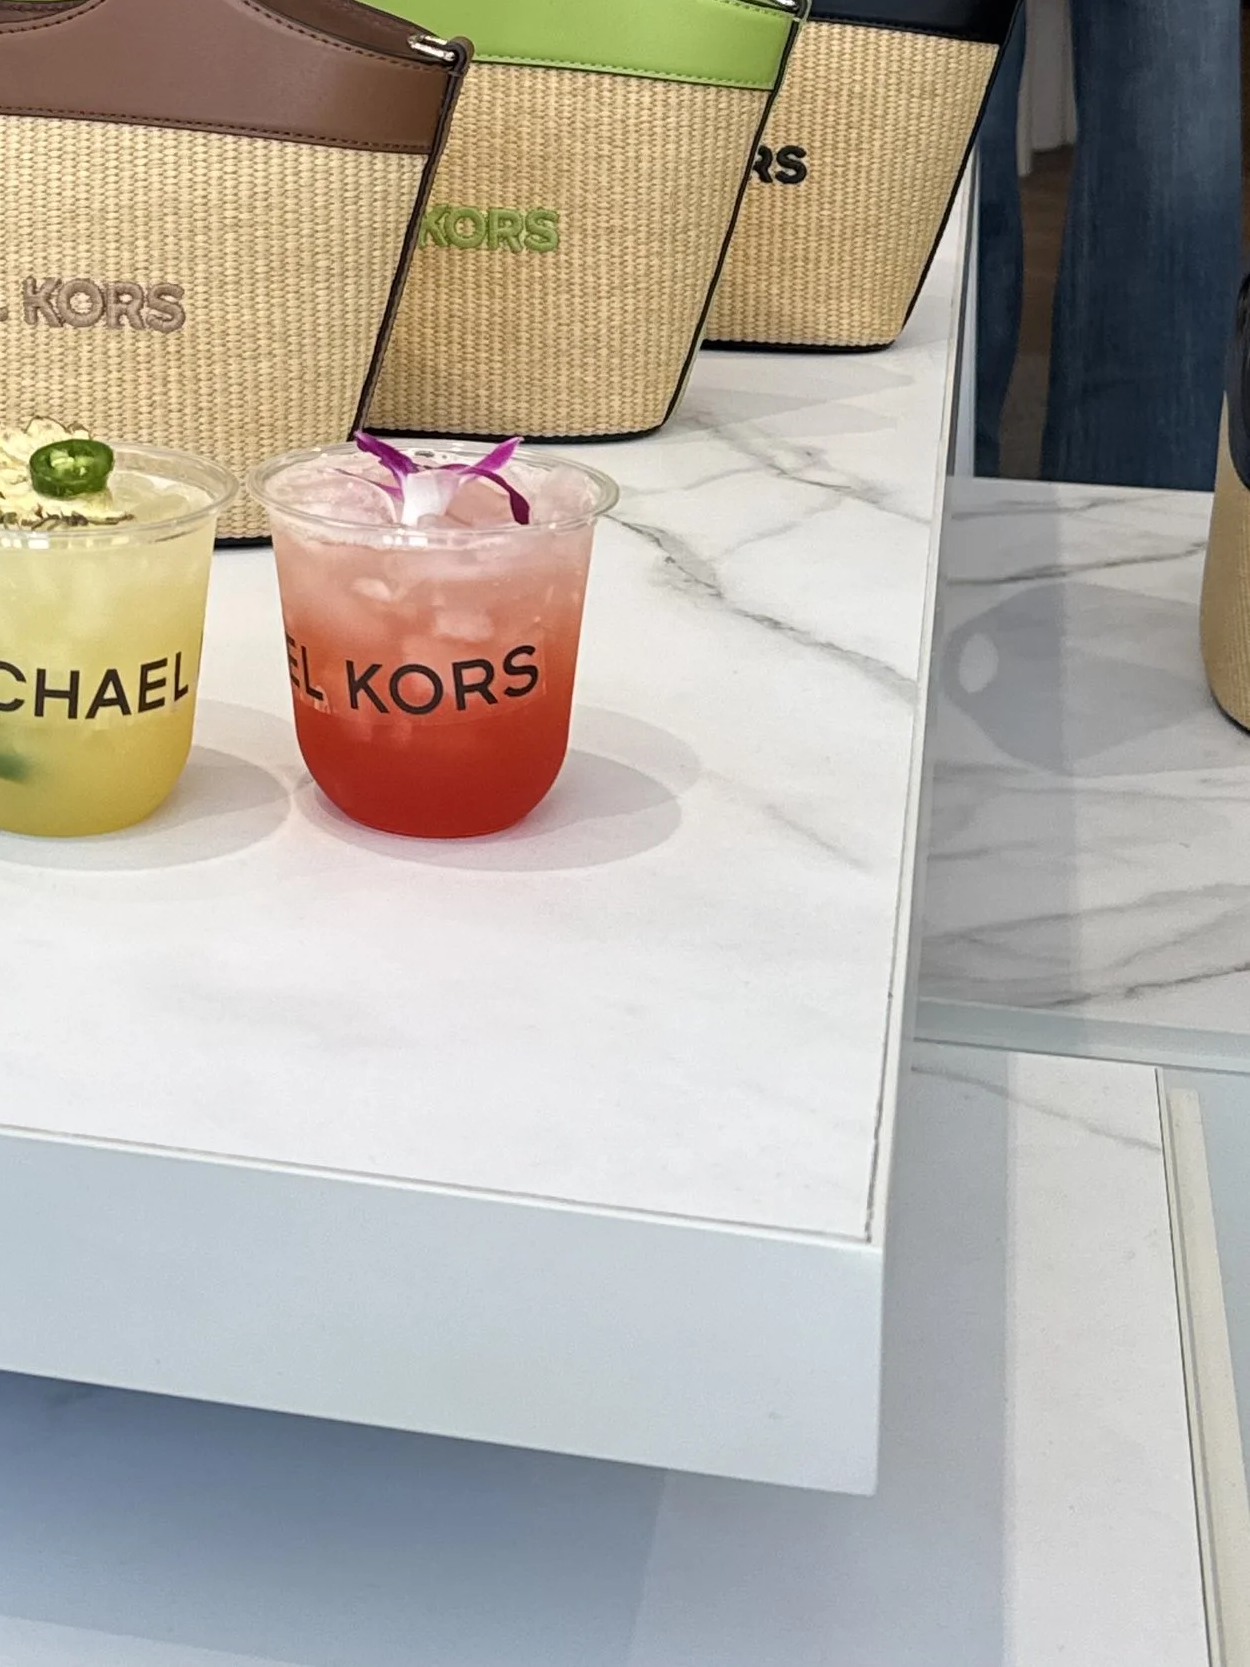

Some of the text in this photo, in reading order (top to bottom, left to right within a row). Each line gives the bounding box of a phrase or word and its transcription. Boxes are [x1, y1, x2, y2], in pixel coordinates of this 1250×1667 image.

[419, 203, 560, 253] KORS
[23, 275, 186, 333] KORS
[345, 644, 540, 716] KORS
